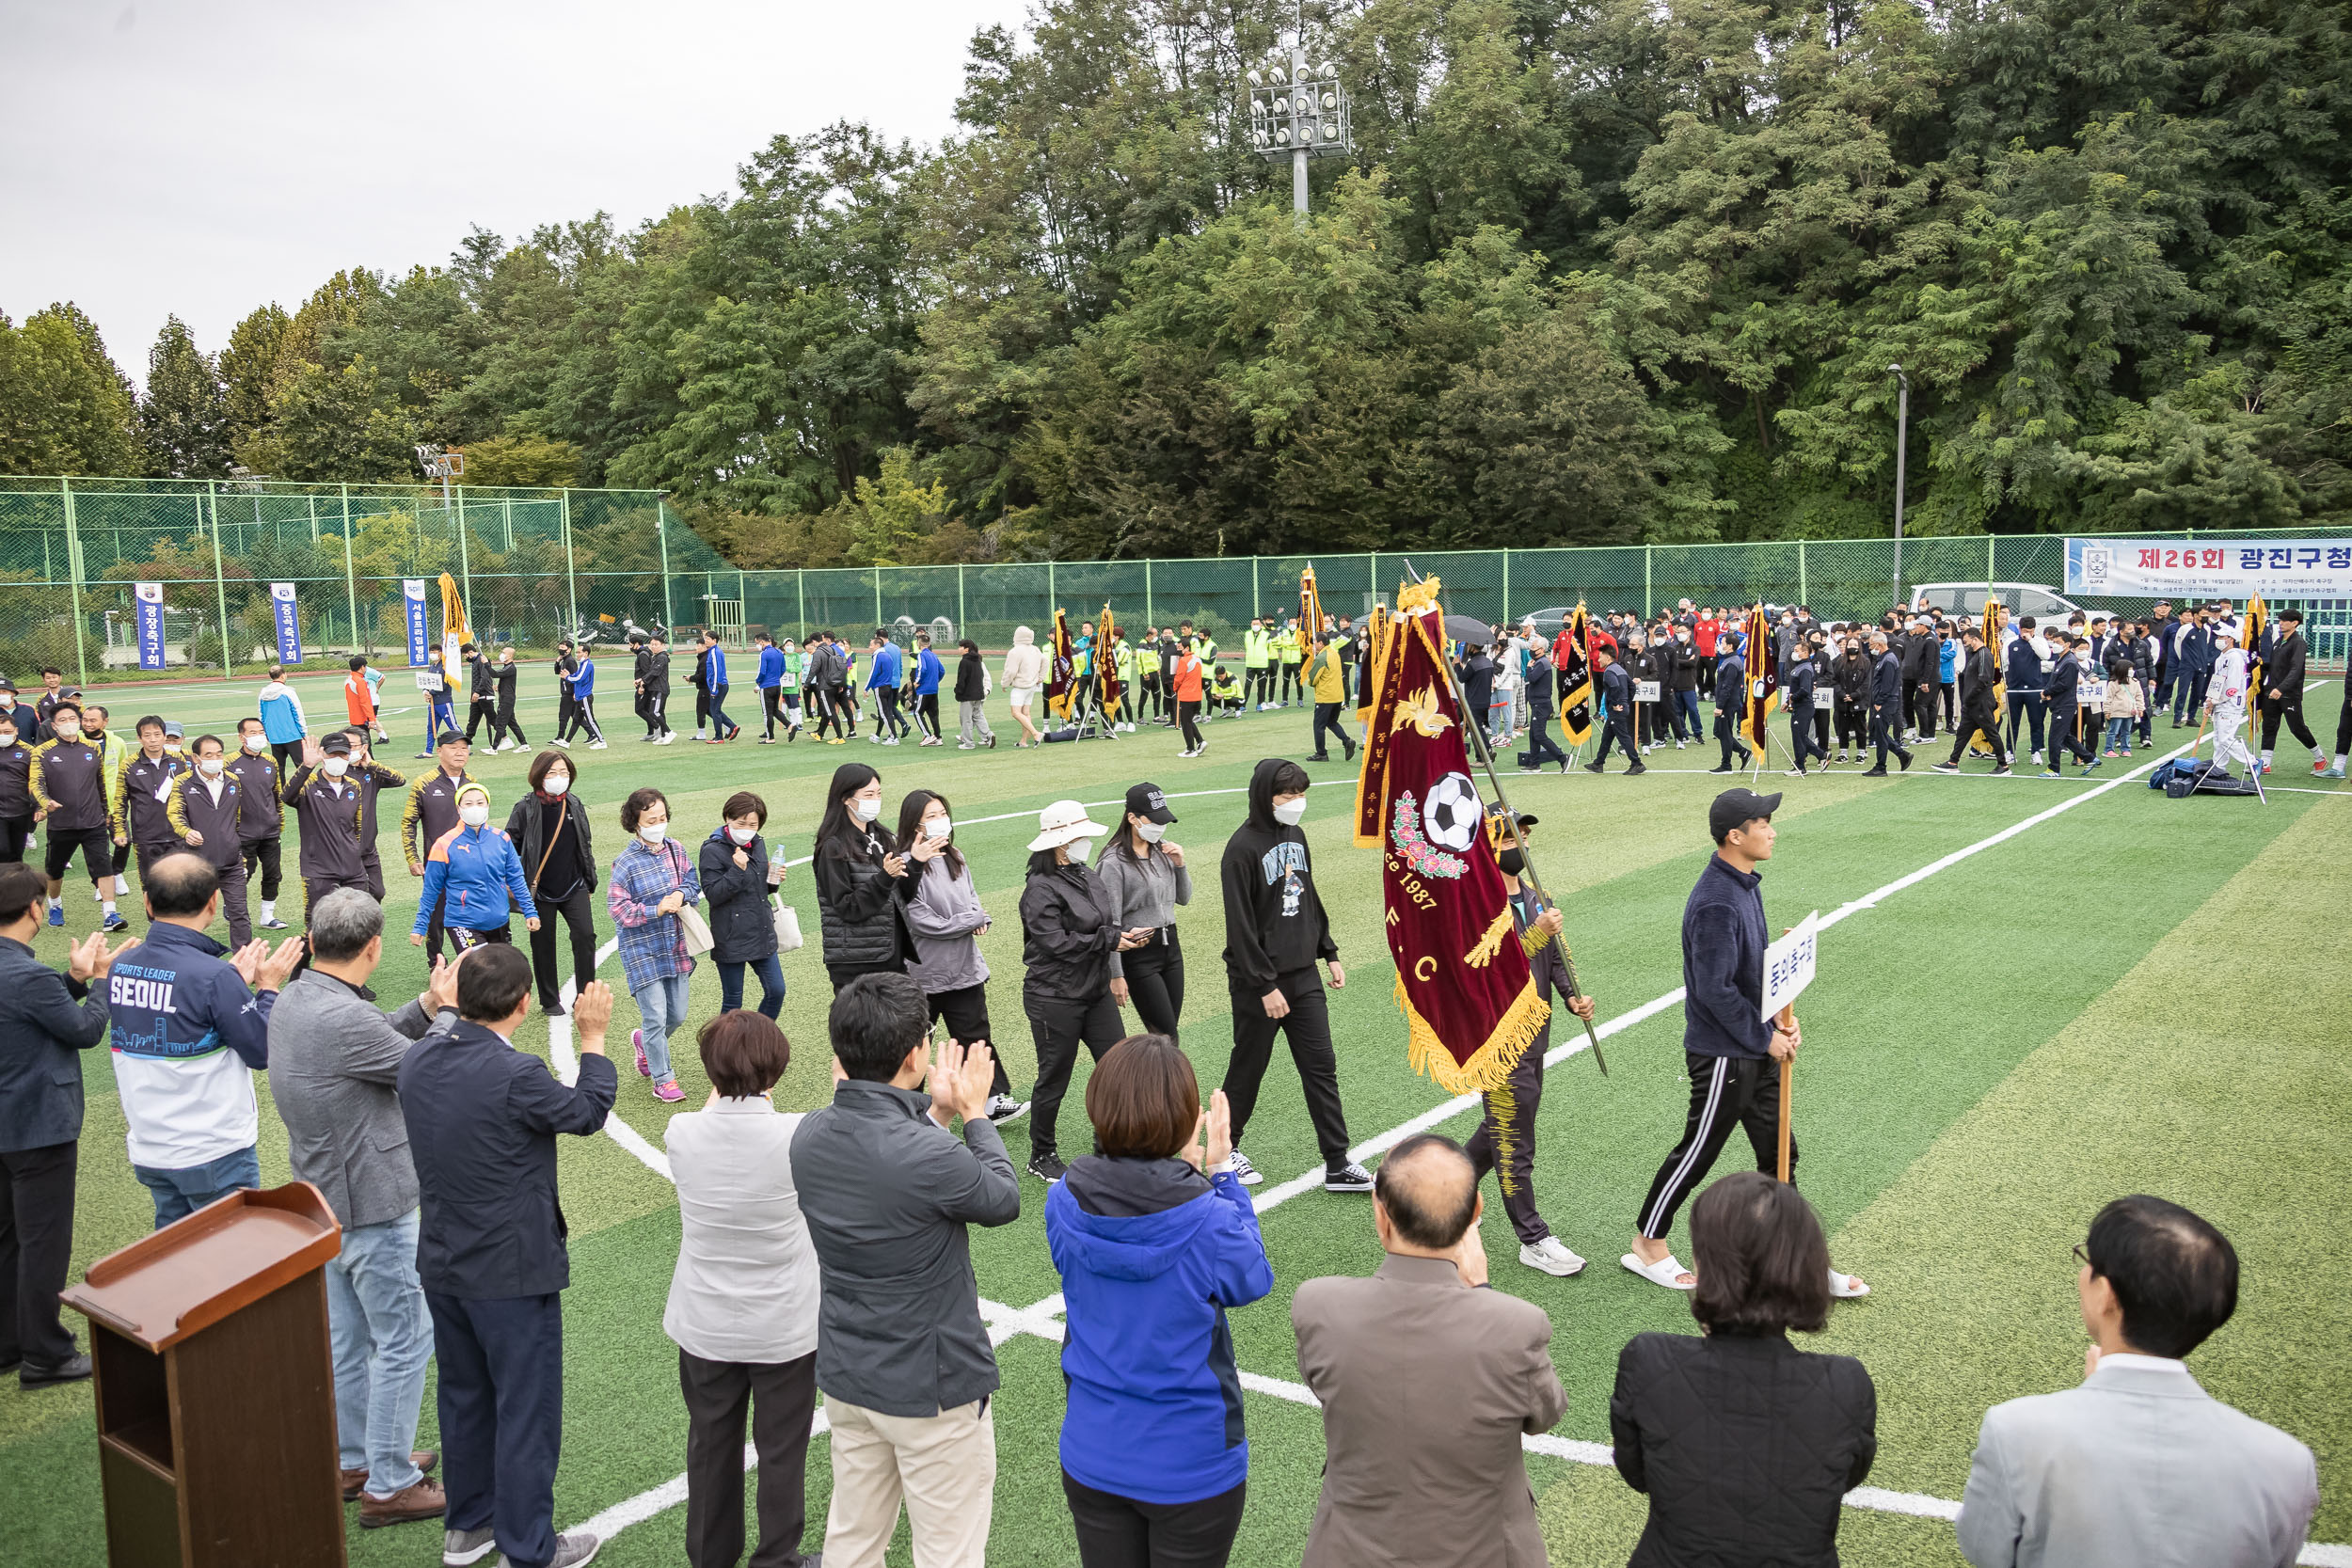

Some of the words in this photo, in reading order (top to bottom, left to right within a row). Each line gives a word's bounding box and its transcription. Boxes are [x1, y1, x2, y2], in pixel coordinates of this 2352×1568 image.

[2137, 547, 2224, 570] 제26회
[2239, 546, 2351, 570] 광진구청
[145, 604, 160, 667] 광장축구회
[280, 603, 297, 662] 중곡축구회
[412, 603, 425, 662] 서울프라임병원
[1399, 872, 1438, 911] 1987
[114, 962, 143, 976] SPORTS
[143, 968, 176, 982] LEADER
[111, 975, 177, 1014] SEOUL
